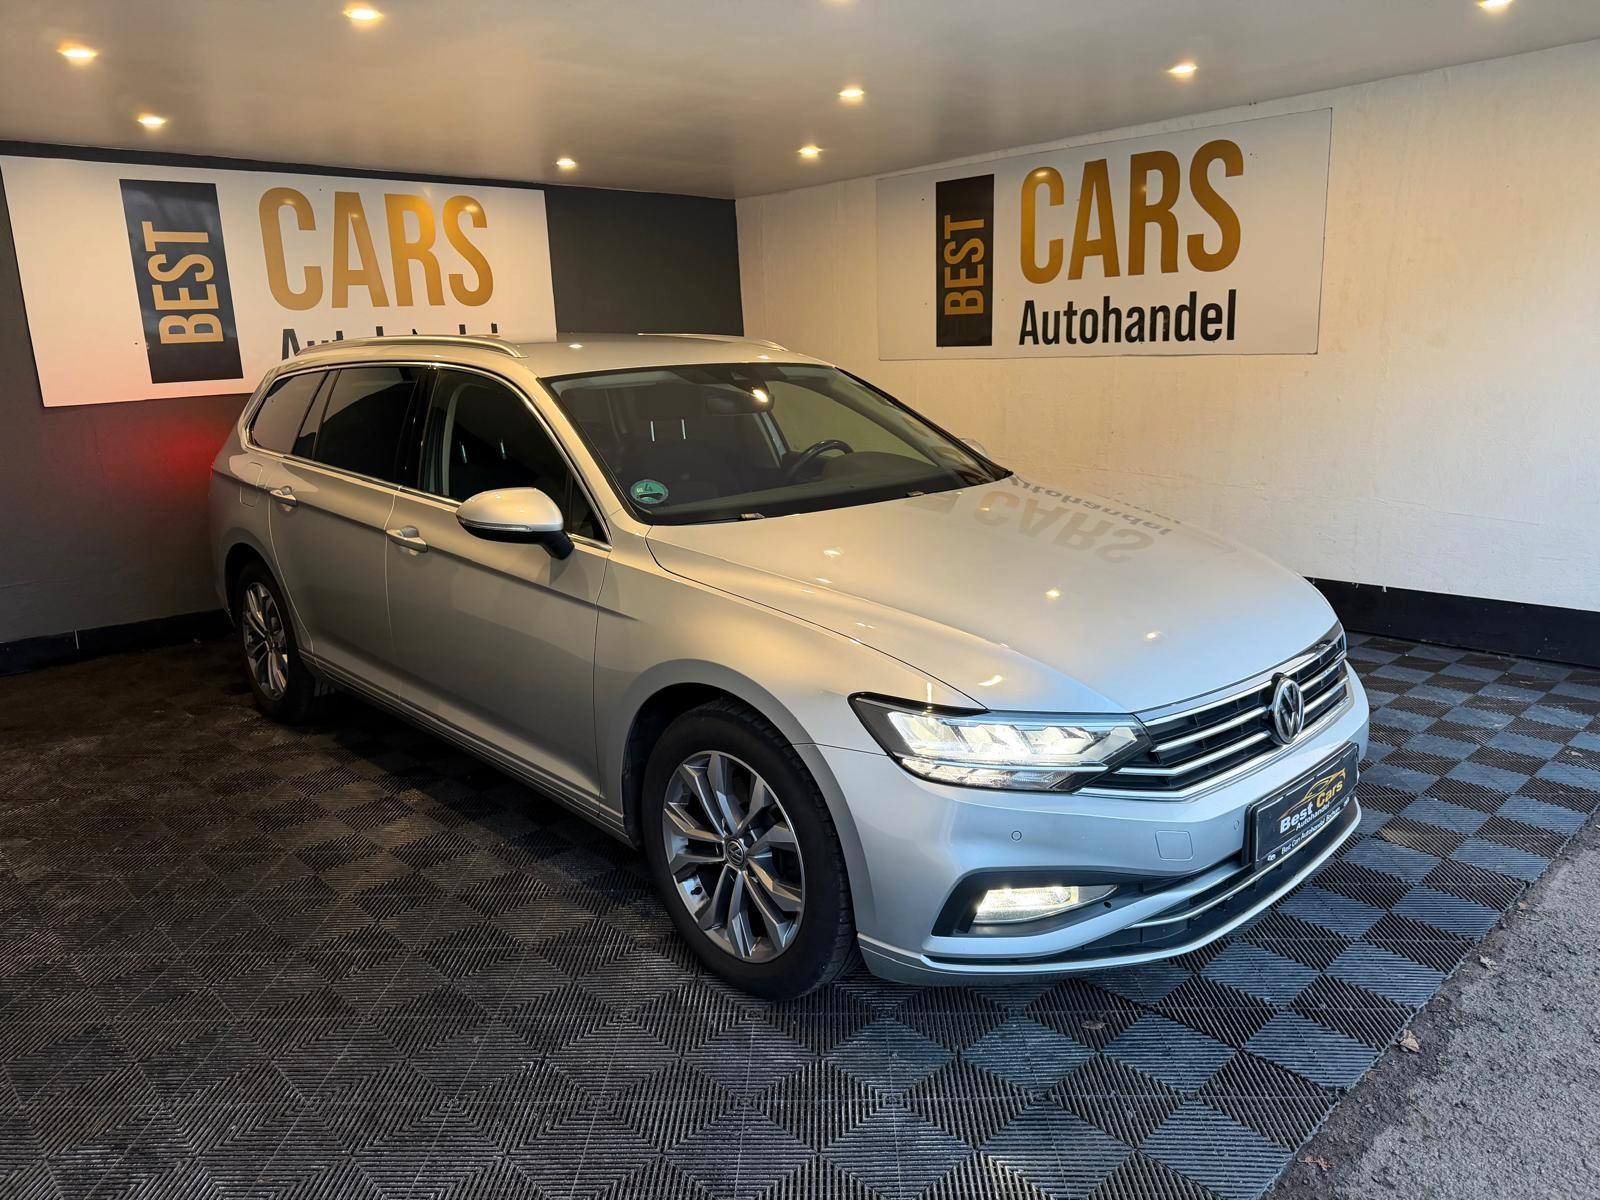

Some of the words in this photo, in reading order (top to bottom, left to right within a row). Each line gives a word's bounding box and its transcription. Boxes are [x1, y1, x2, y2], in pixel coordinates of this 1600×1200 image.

[258, 186, 494, 312] CARS
[944, 214, 985, 316] BEST
[1020, 138, 1244, 285] CARS
[142, 220, 224, 345] BEST
[1018, 289, 1237, 346] Autohandel
[1280, 801, 1313, 833] Best
[1316, 781, 1343, 808] Cars
